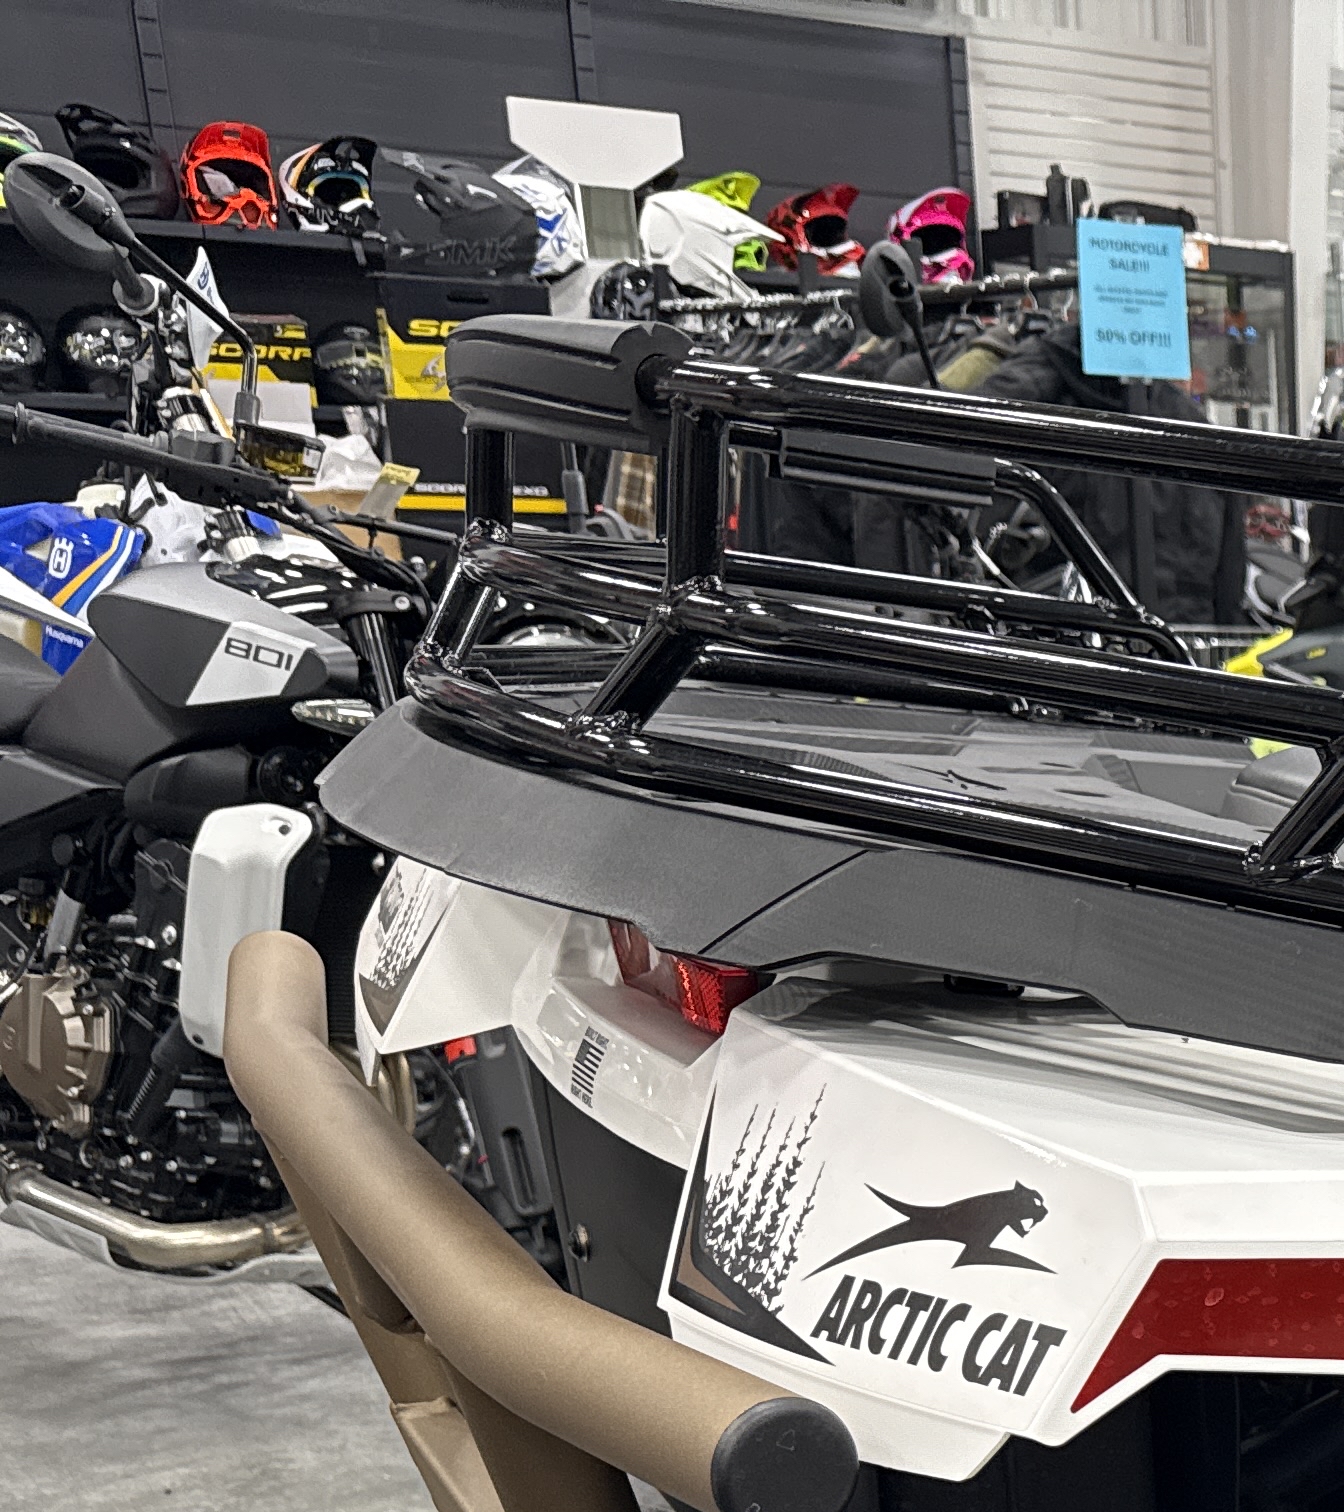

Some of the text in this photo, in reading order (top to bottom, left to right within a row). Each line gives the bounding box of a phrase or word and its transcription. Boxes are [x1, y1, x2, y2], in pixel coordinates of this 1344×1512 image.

[1088, 237, 1170, 257] MOTORCYCLE
[1095, 328, 1127, 345] 50%
[45, 625, 84, 648] Husqvarna
[224, 637, 294, 671] 801
[810, 1274, 1068, 1397] ARCTIC CAT
